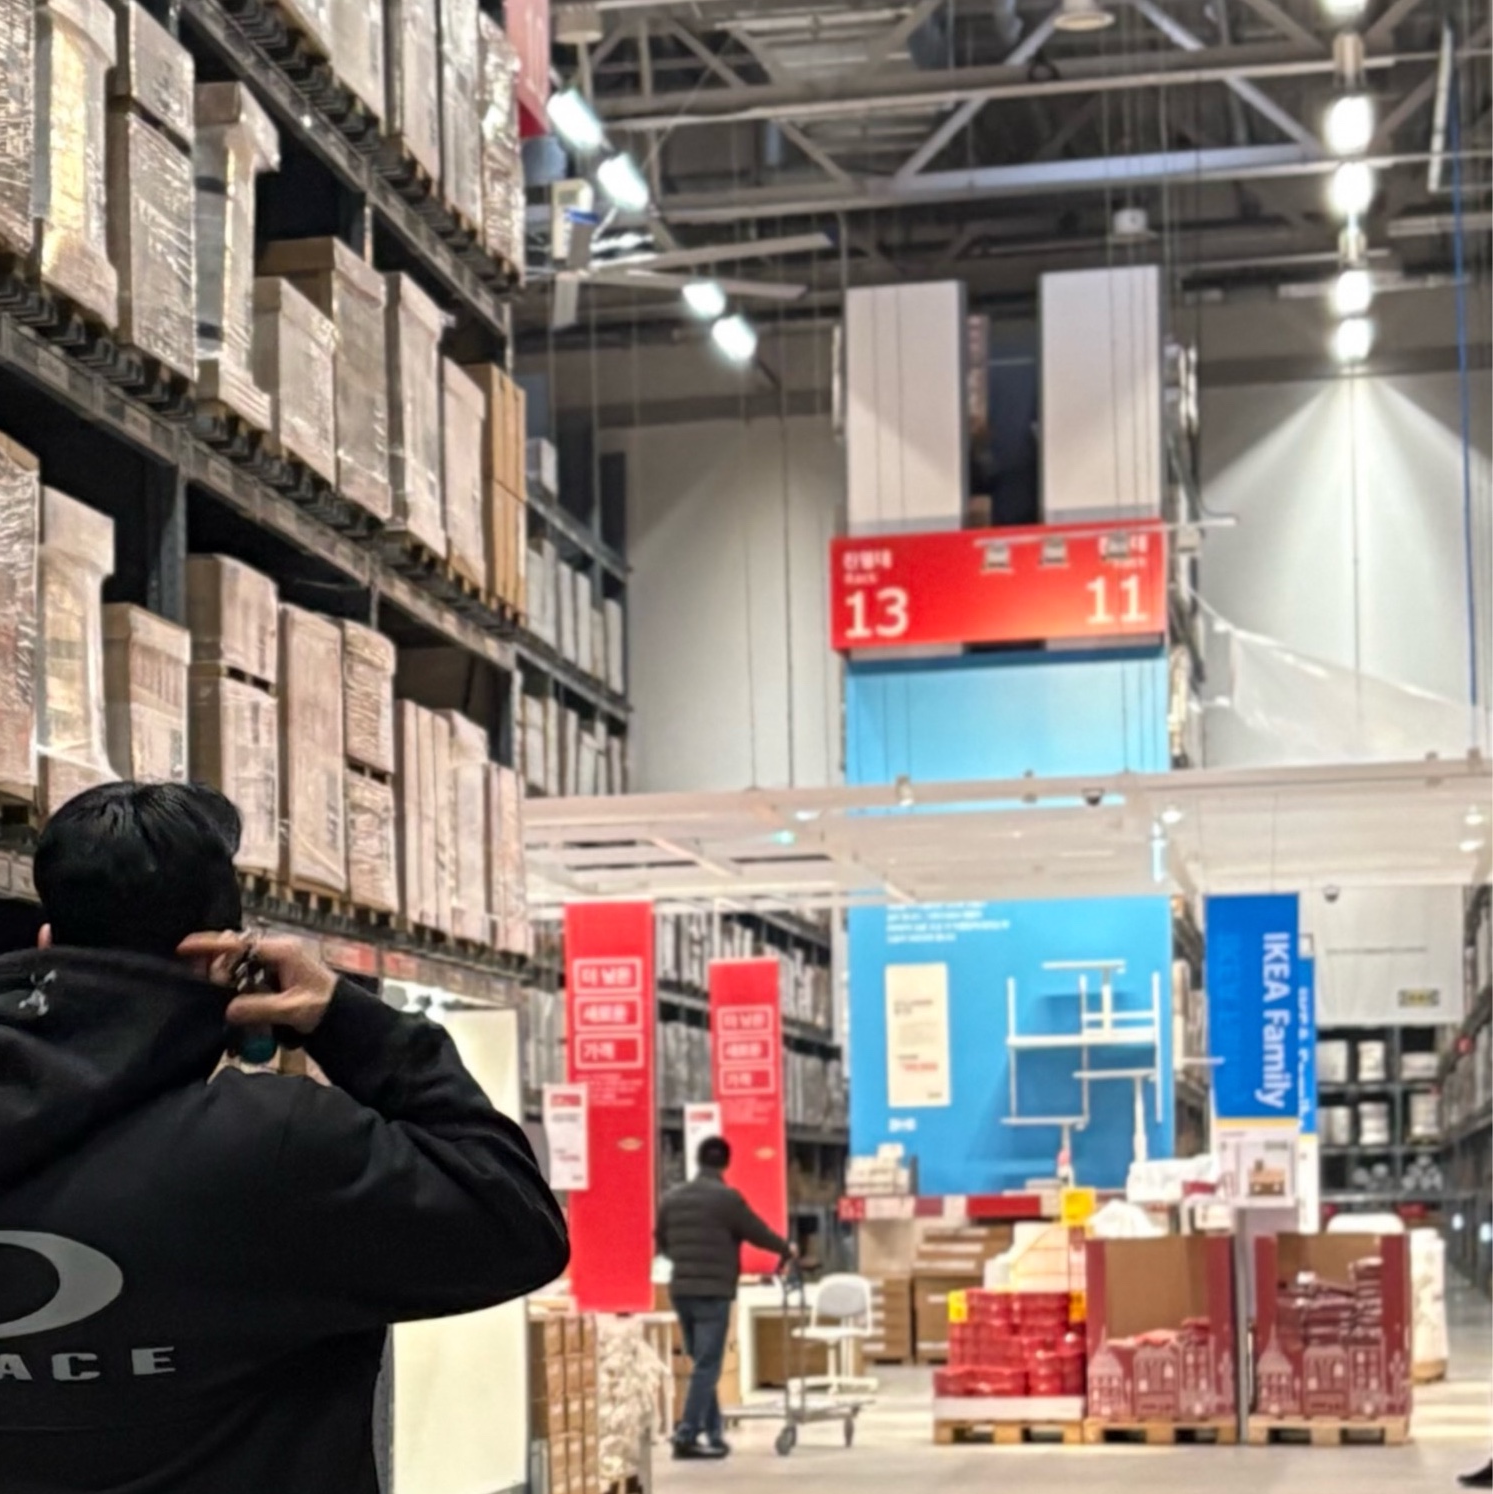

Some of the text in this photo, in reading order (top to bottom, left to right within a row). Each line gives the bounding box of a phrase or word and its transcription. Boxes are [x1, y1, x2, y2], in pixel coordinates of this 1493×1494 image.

[844, 587, 909, 638] 13
[1085, 573, 1149, 624] 11
[1254, 932, 1292, 1109] IKEA Family
